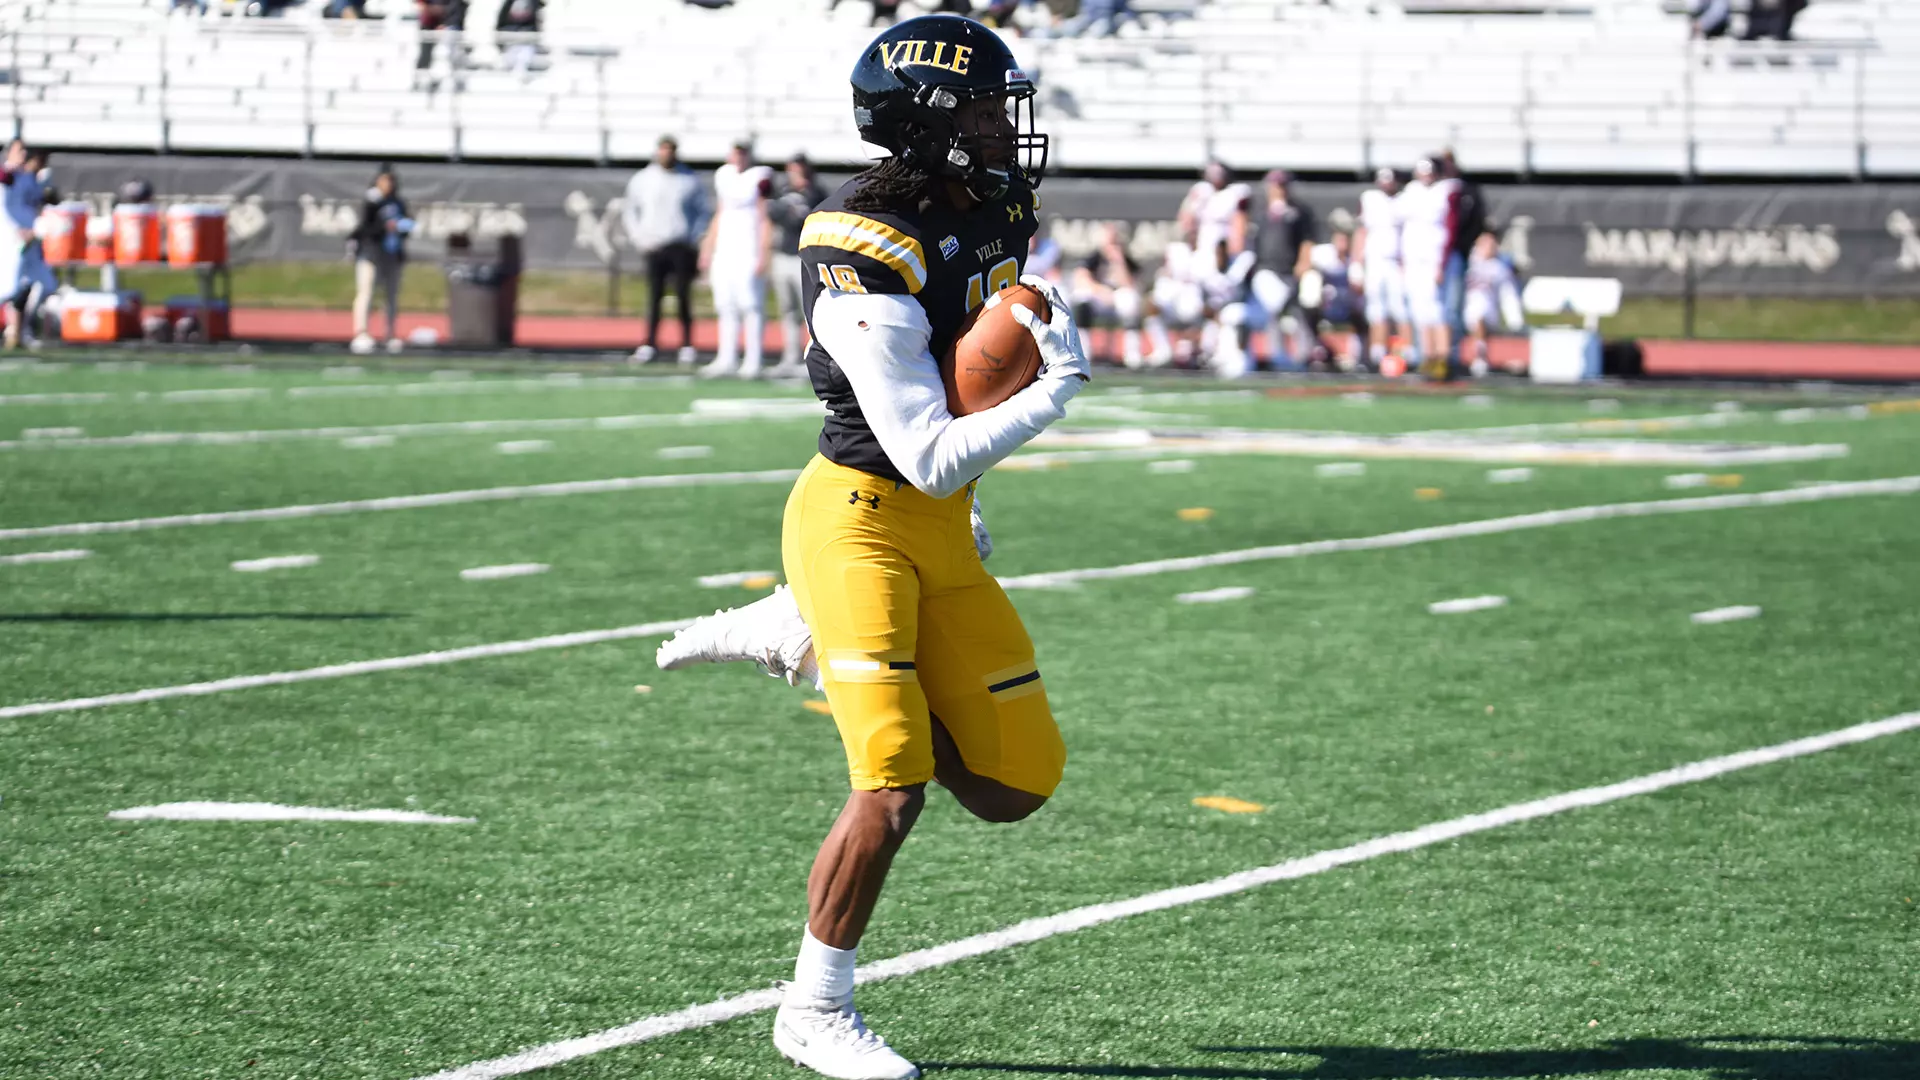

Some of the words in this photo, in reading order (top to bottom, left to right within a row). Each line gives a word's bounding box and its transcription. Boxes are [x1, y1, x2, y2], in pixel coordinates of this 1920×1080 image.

[880, 40, 973, 75] VILLE
[976, 238, 1003, 263] VILLE
[1585, 222, 1840, 272] MARAUDERS
